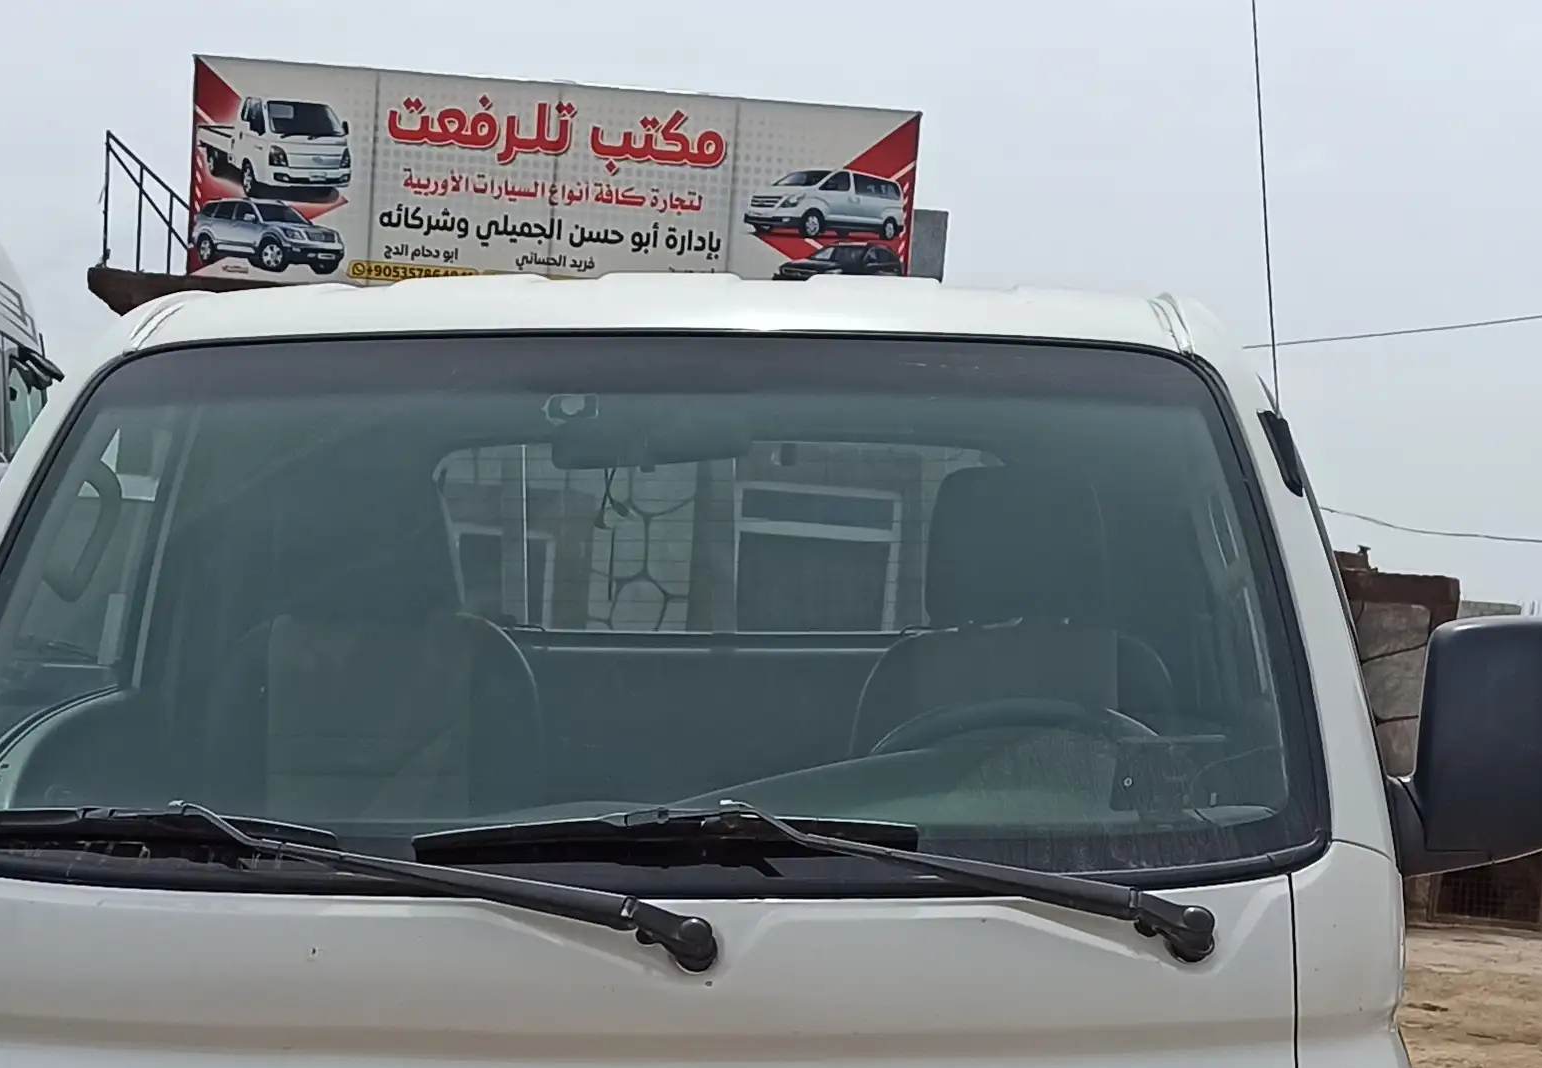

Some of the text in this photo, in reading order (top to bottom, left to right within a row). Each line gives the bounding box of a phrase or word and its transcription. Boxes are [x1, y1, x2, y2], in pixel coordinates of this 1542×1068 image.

[388, 94, 726, 175] مكتب تلرفعت
[473, 174, 545, 202] السيارات
[594, 181, 646, 207] كافة
[649, 186, 703, 215] لتجارة
[379, 203, 721, 260] بإدارة أبو حسن الجميلي وشركائه
[515, 251, 595, 272] فريد الحساني
